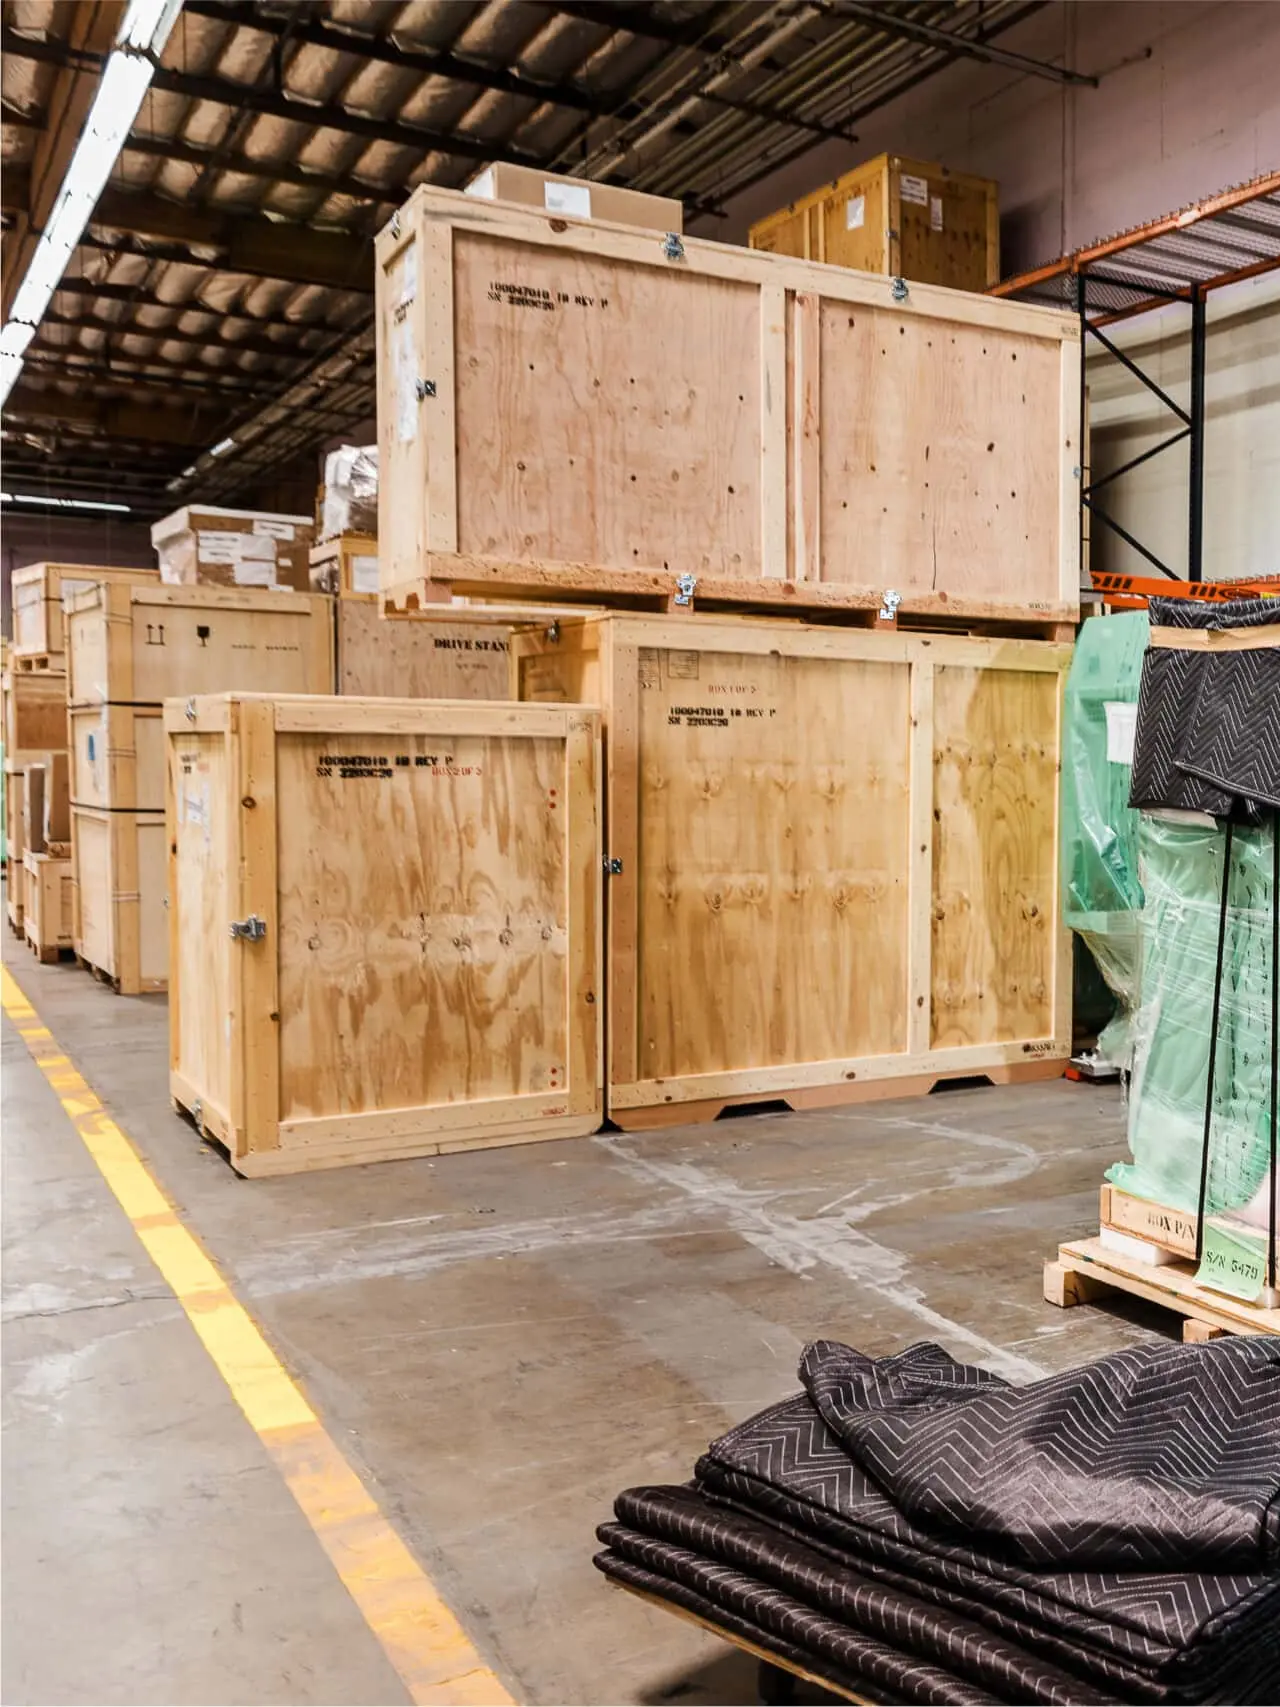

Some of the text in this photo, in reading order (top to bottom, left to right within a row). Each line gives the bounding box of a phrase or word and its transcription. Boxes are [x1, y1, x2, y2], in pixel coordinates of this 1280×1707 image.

[434, 638, 473, 650] DRIVE
[746, 707, 765, 717] REV
[1147, 1211, 1172, 1233] BOX
[1175, 1219, 1196, 1240] P/N
[1206, 1250, 1259, 1281] S/N 5479
